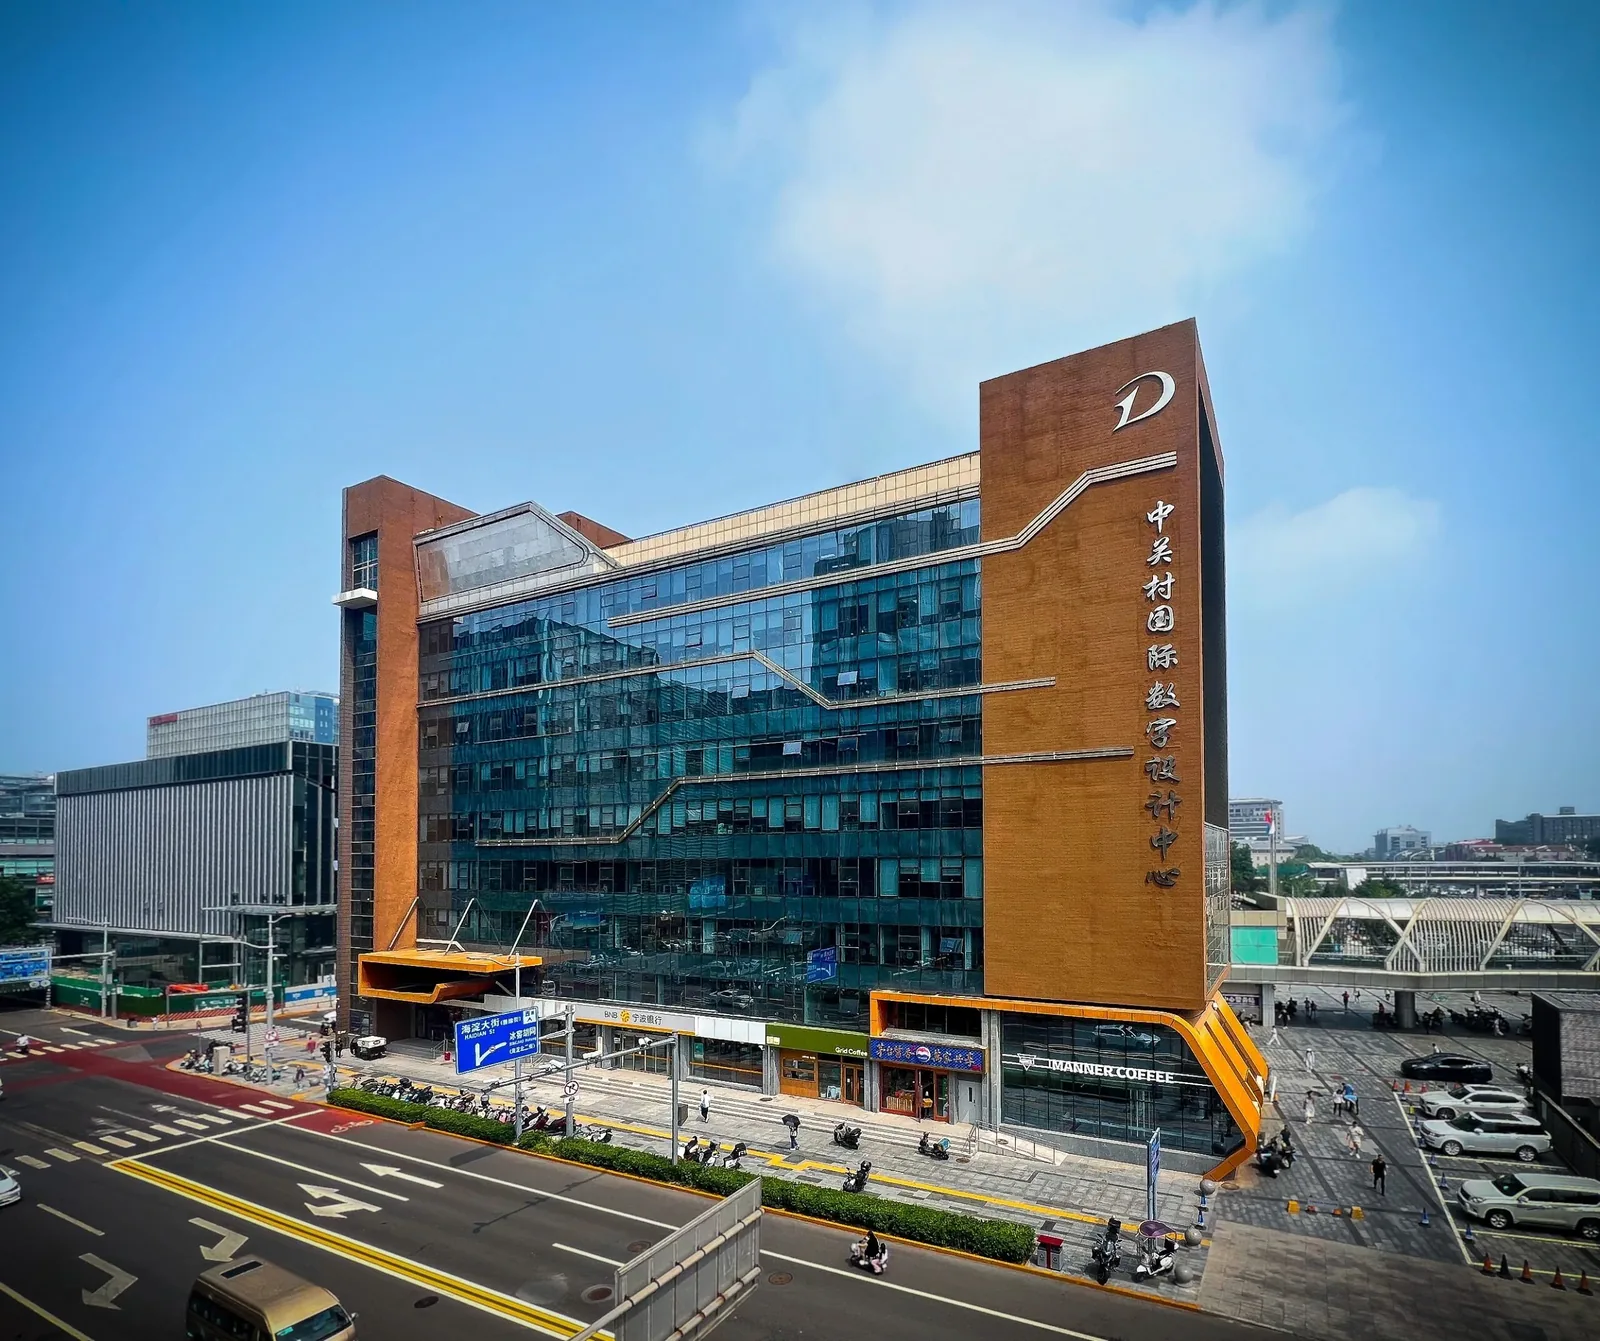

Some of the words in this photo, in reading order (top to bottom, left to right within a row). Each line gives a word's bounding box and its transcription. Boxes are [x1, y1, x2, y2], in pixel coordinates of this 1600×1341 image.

[1144, 500, 1182, 888] 中关村国际数字设计中心
[461, 1018, 500, 1035] 海淀大街
[632, 1013, 662, 1026] 宁波银行
[464, 1030, 487, 1040] HAIDIAN
[834, 1046, 848, 1055] Grid
[848, 1048, 868, 1057] Coffee
[1051, 1059, 1114, 1077] MANNER
[1115, 1066, 1175, 1084] COFFEE
